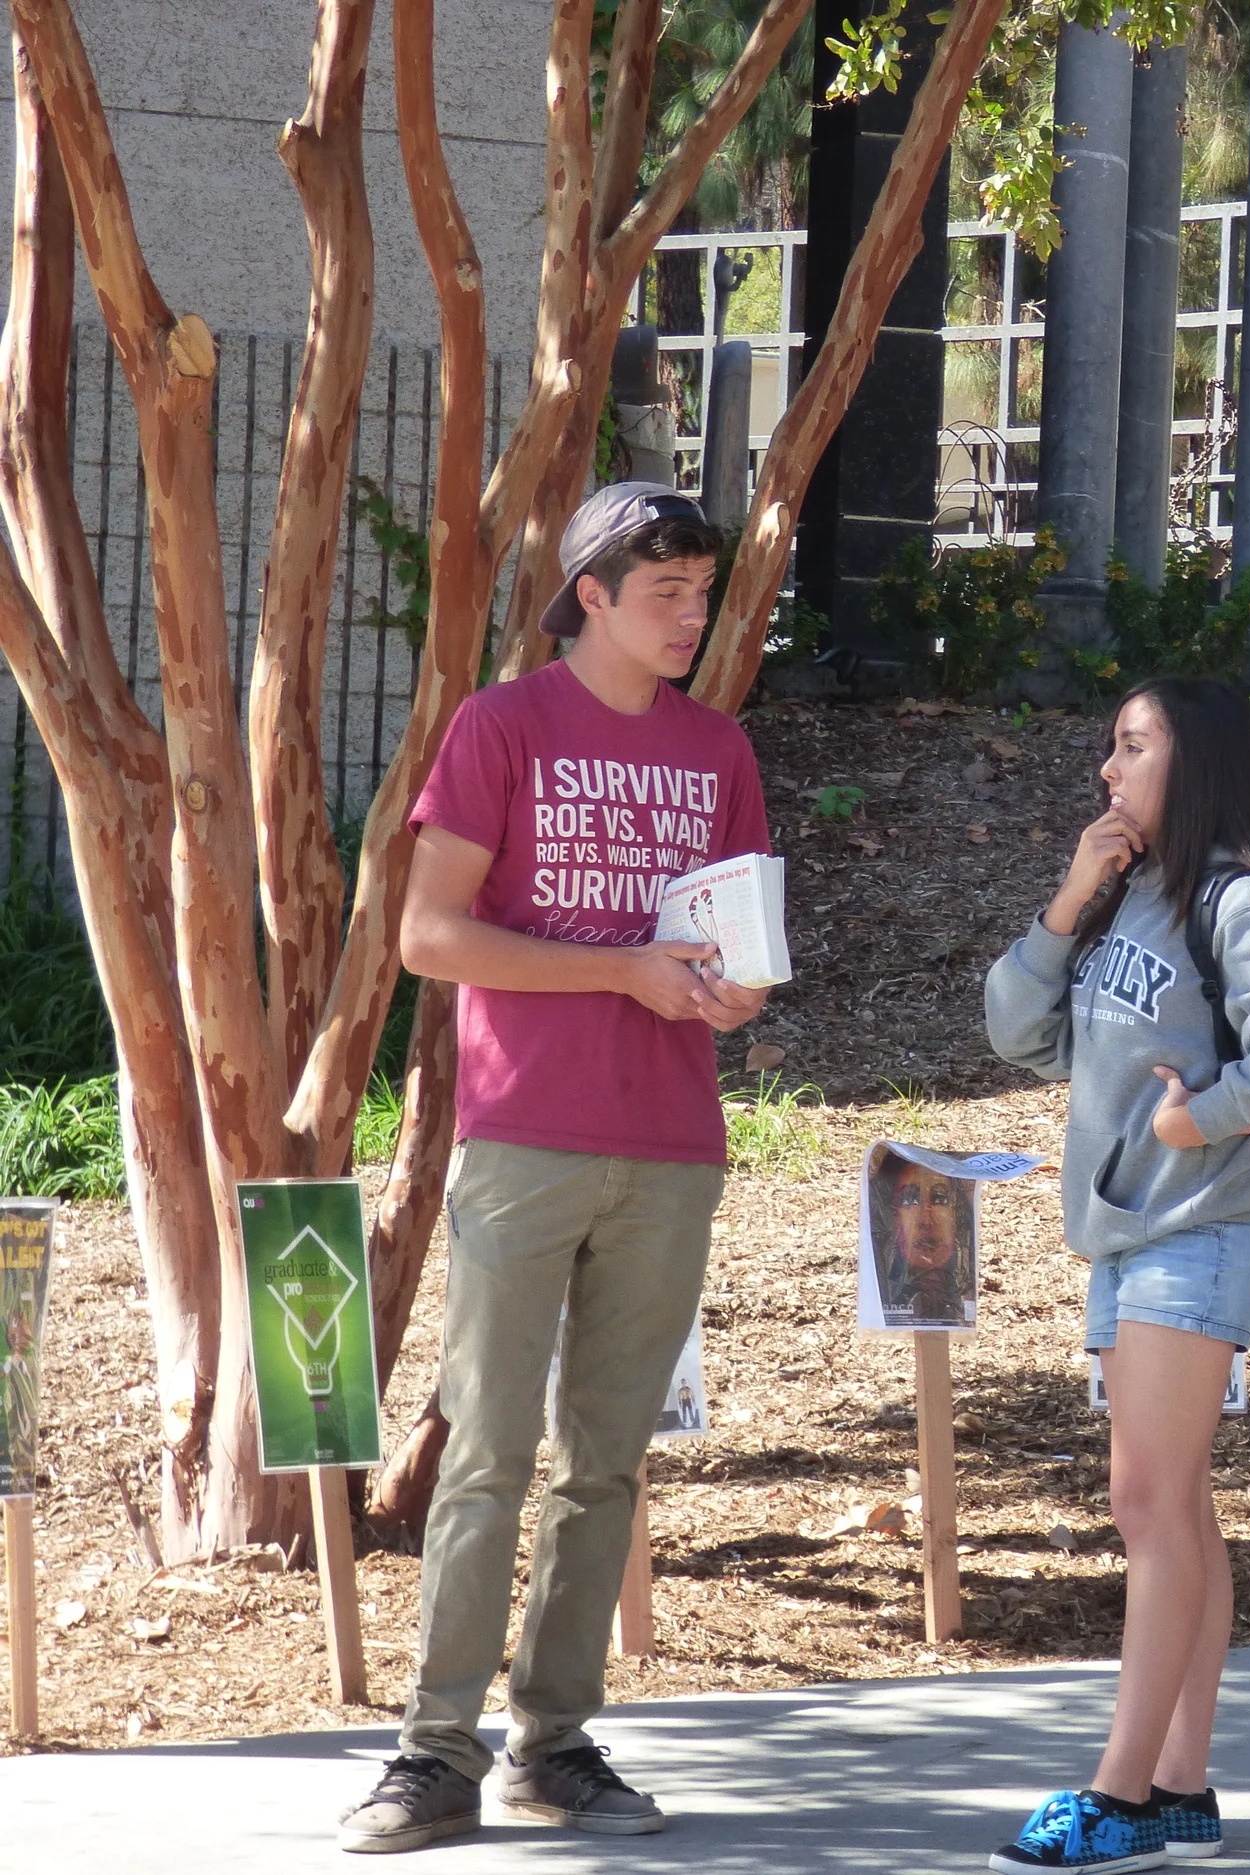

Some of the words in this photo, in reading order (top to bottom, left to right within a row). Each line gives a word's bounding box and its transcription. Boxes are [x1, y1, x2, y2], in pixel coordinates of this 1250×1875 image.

[534, 757, 543, 798] I
[553, 758, 718, 814] SURVIVED
[535, 803, 596, 838] ROE
[602, 805, 643, 842] VS.
[536, 842, 570, 863] ROE
[574, 842, 602, 863] VS.
[607, 844, 652, 868] WADE
[526, 909, 652, 946] Stand
[0, 1245, 45, 1269] LENT
[264, 1259, 328, 1285] graduate
[306, 1362, 328, 1376] 6TH
